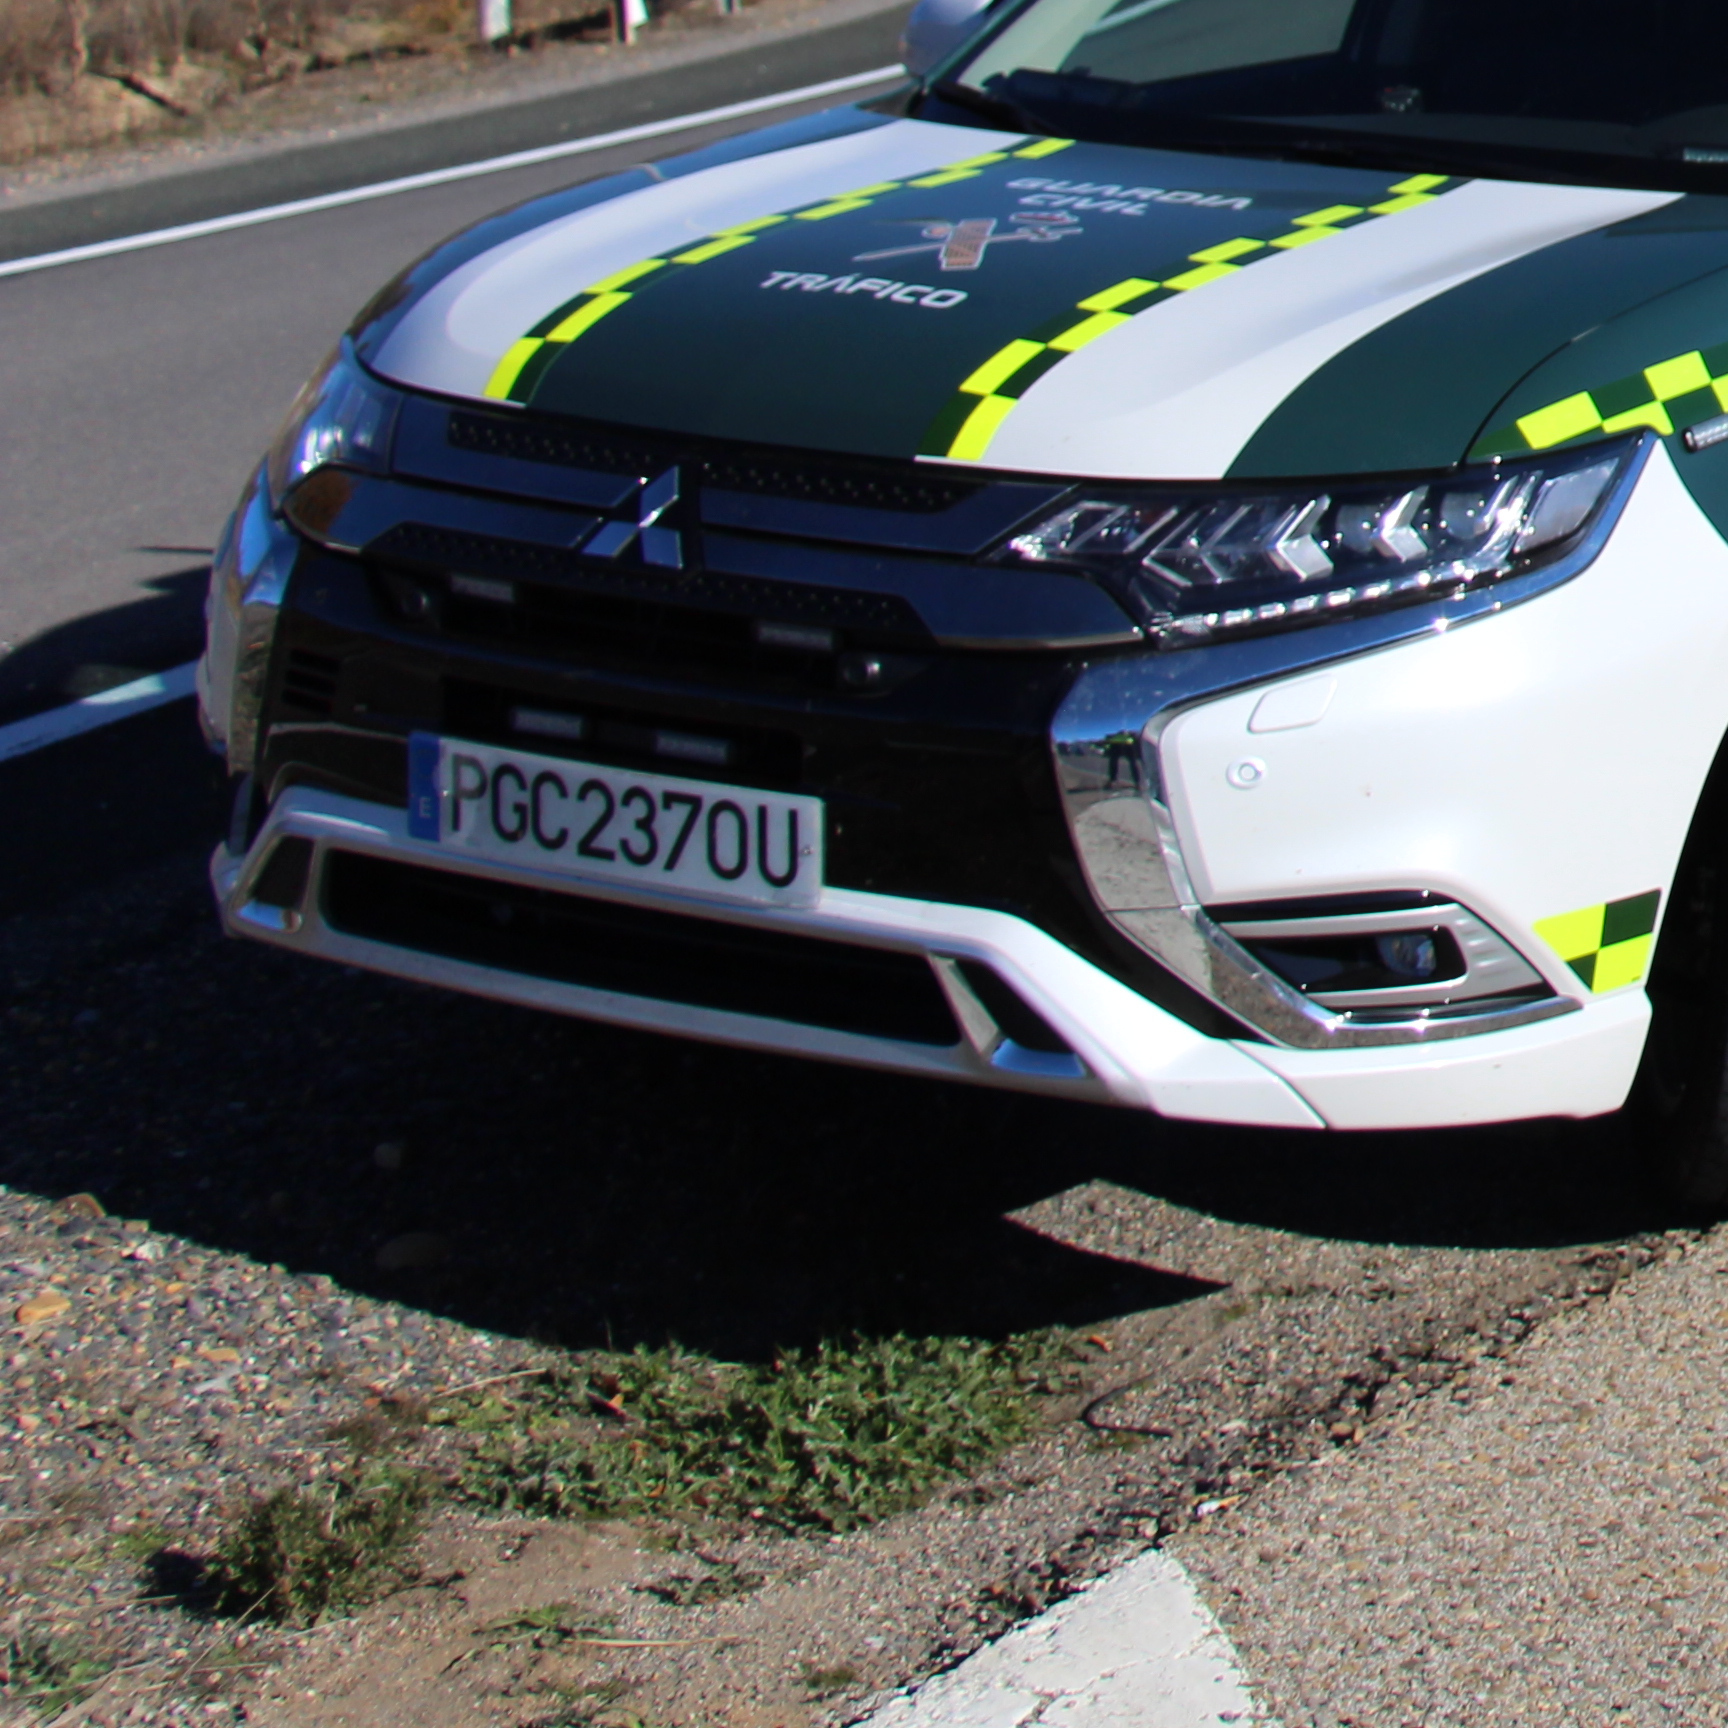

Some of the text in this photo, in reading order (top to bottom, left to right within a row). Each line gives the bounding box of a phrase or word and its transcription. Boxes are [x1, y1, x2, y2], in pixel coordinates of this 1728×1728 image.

[1008, 177, 1254, 210] GUARDIA
[1019, 193, 1150, 216] CIVIL
[760, 271, 968, 309] TRÁFICO
[418, 753, 799, 889] E PGC2370U
